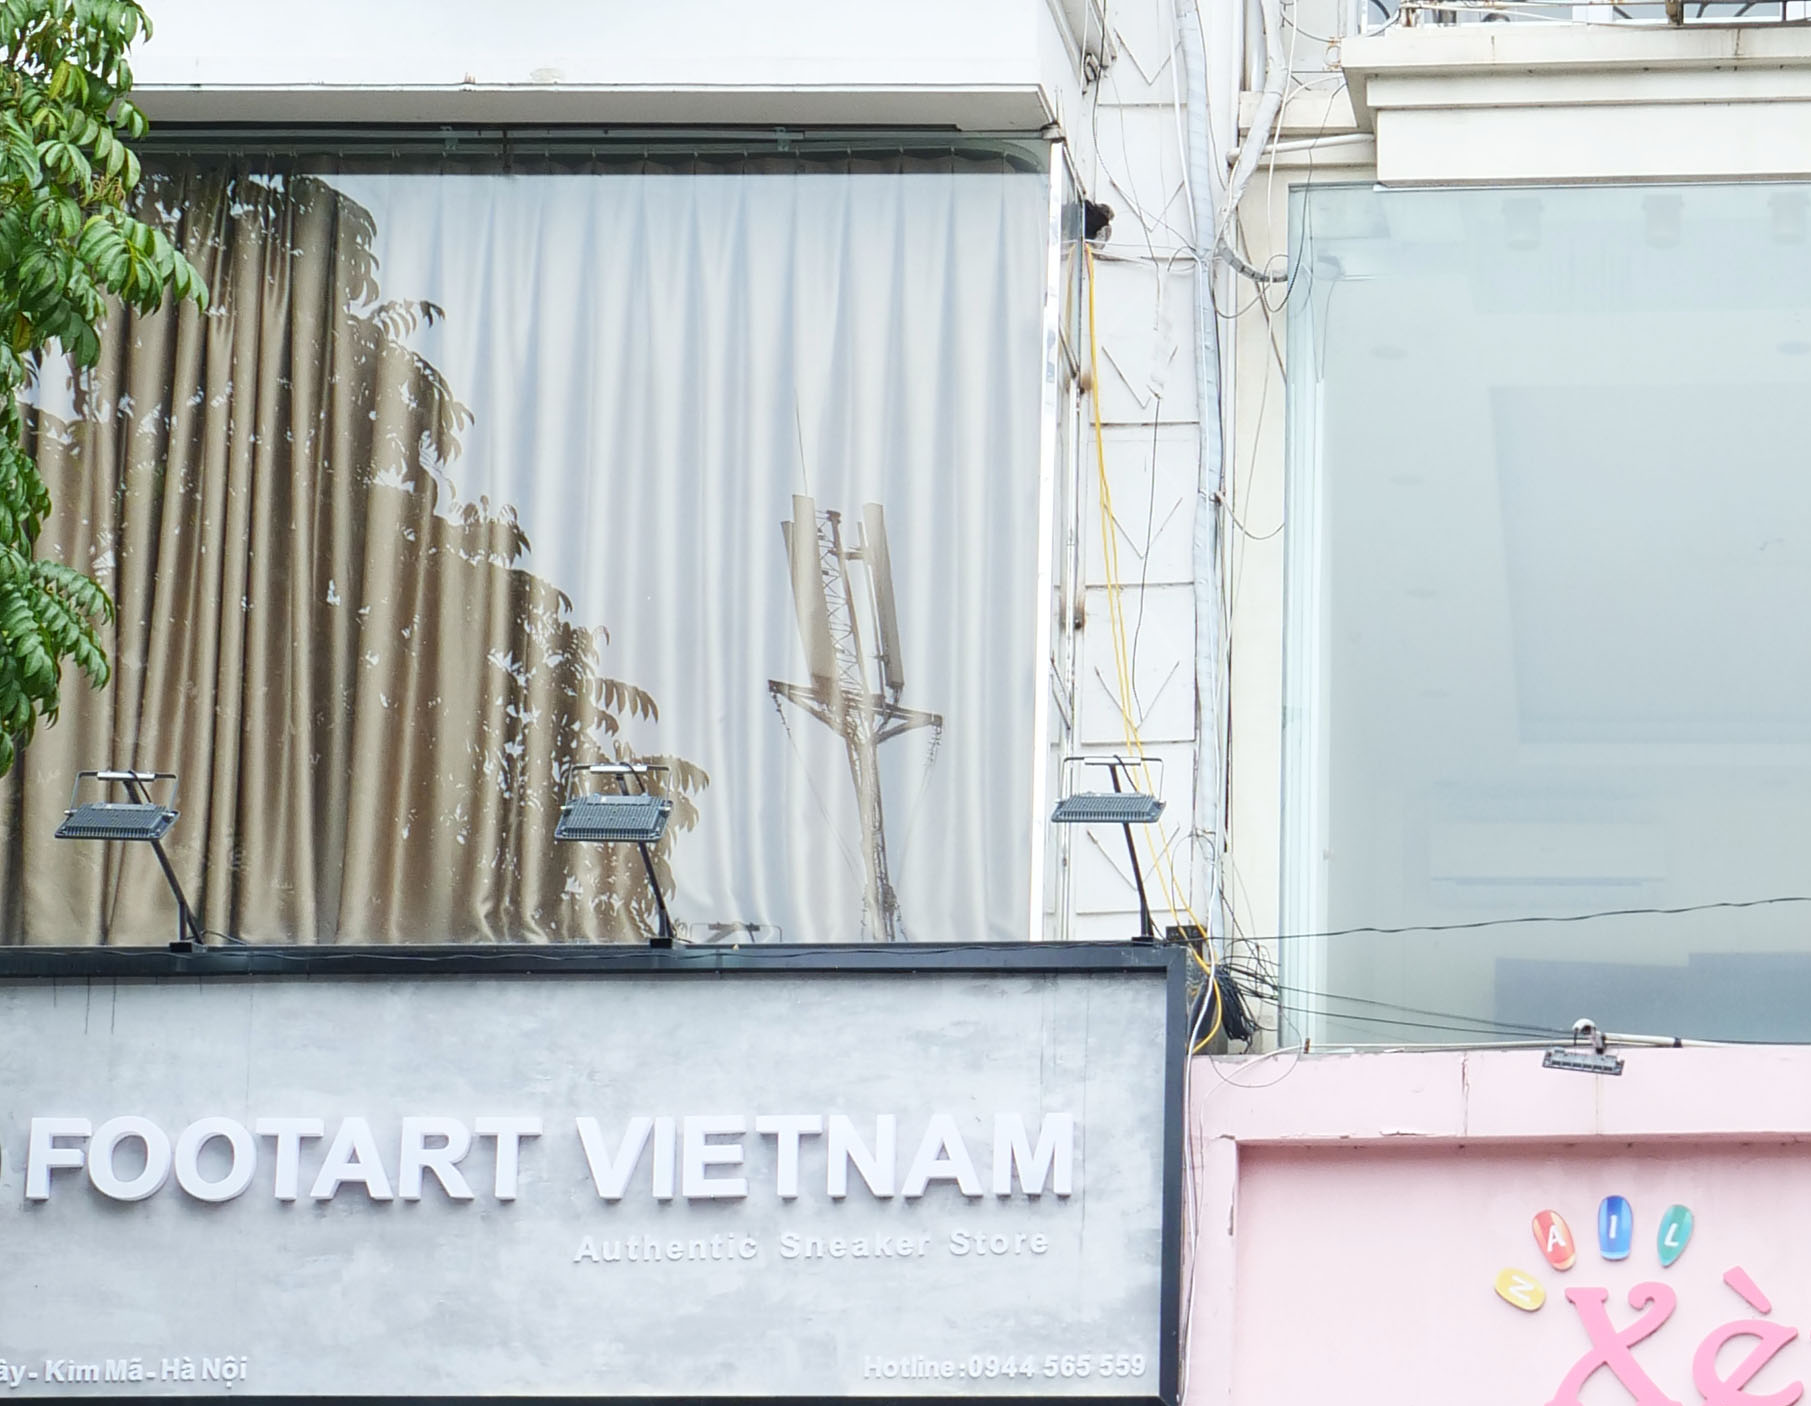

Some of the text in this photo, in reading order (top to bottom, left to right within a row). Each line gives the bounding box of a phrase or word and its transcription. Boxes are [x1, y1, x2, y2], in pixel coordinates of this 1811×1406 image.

[26, 1112, 1074, 1202] FOOTART VIETNAM
[574, 1229, 1050, 1263] Authentic Sneaker Store
[44, 1359, 98, 1383] Kim
[104, 1357, 144, 1382] Mã
[160, 1357, 196, 1382] Hà
[201, 1356, 248, 1388] Nội
[1043, 1355, 1092, 1378] 565
[1100, 1354, 1147, 1377] 559
